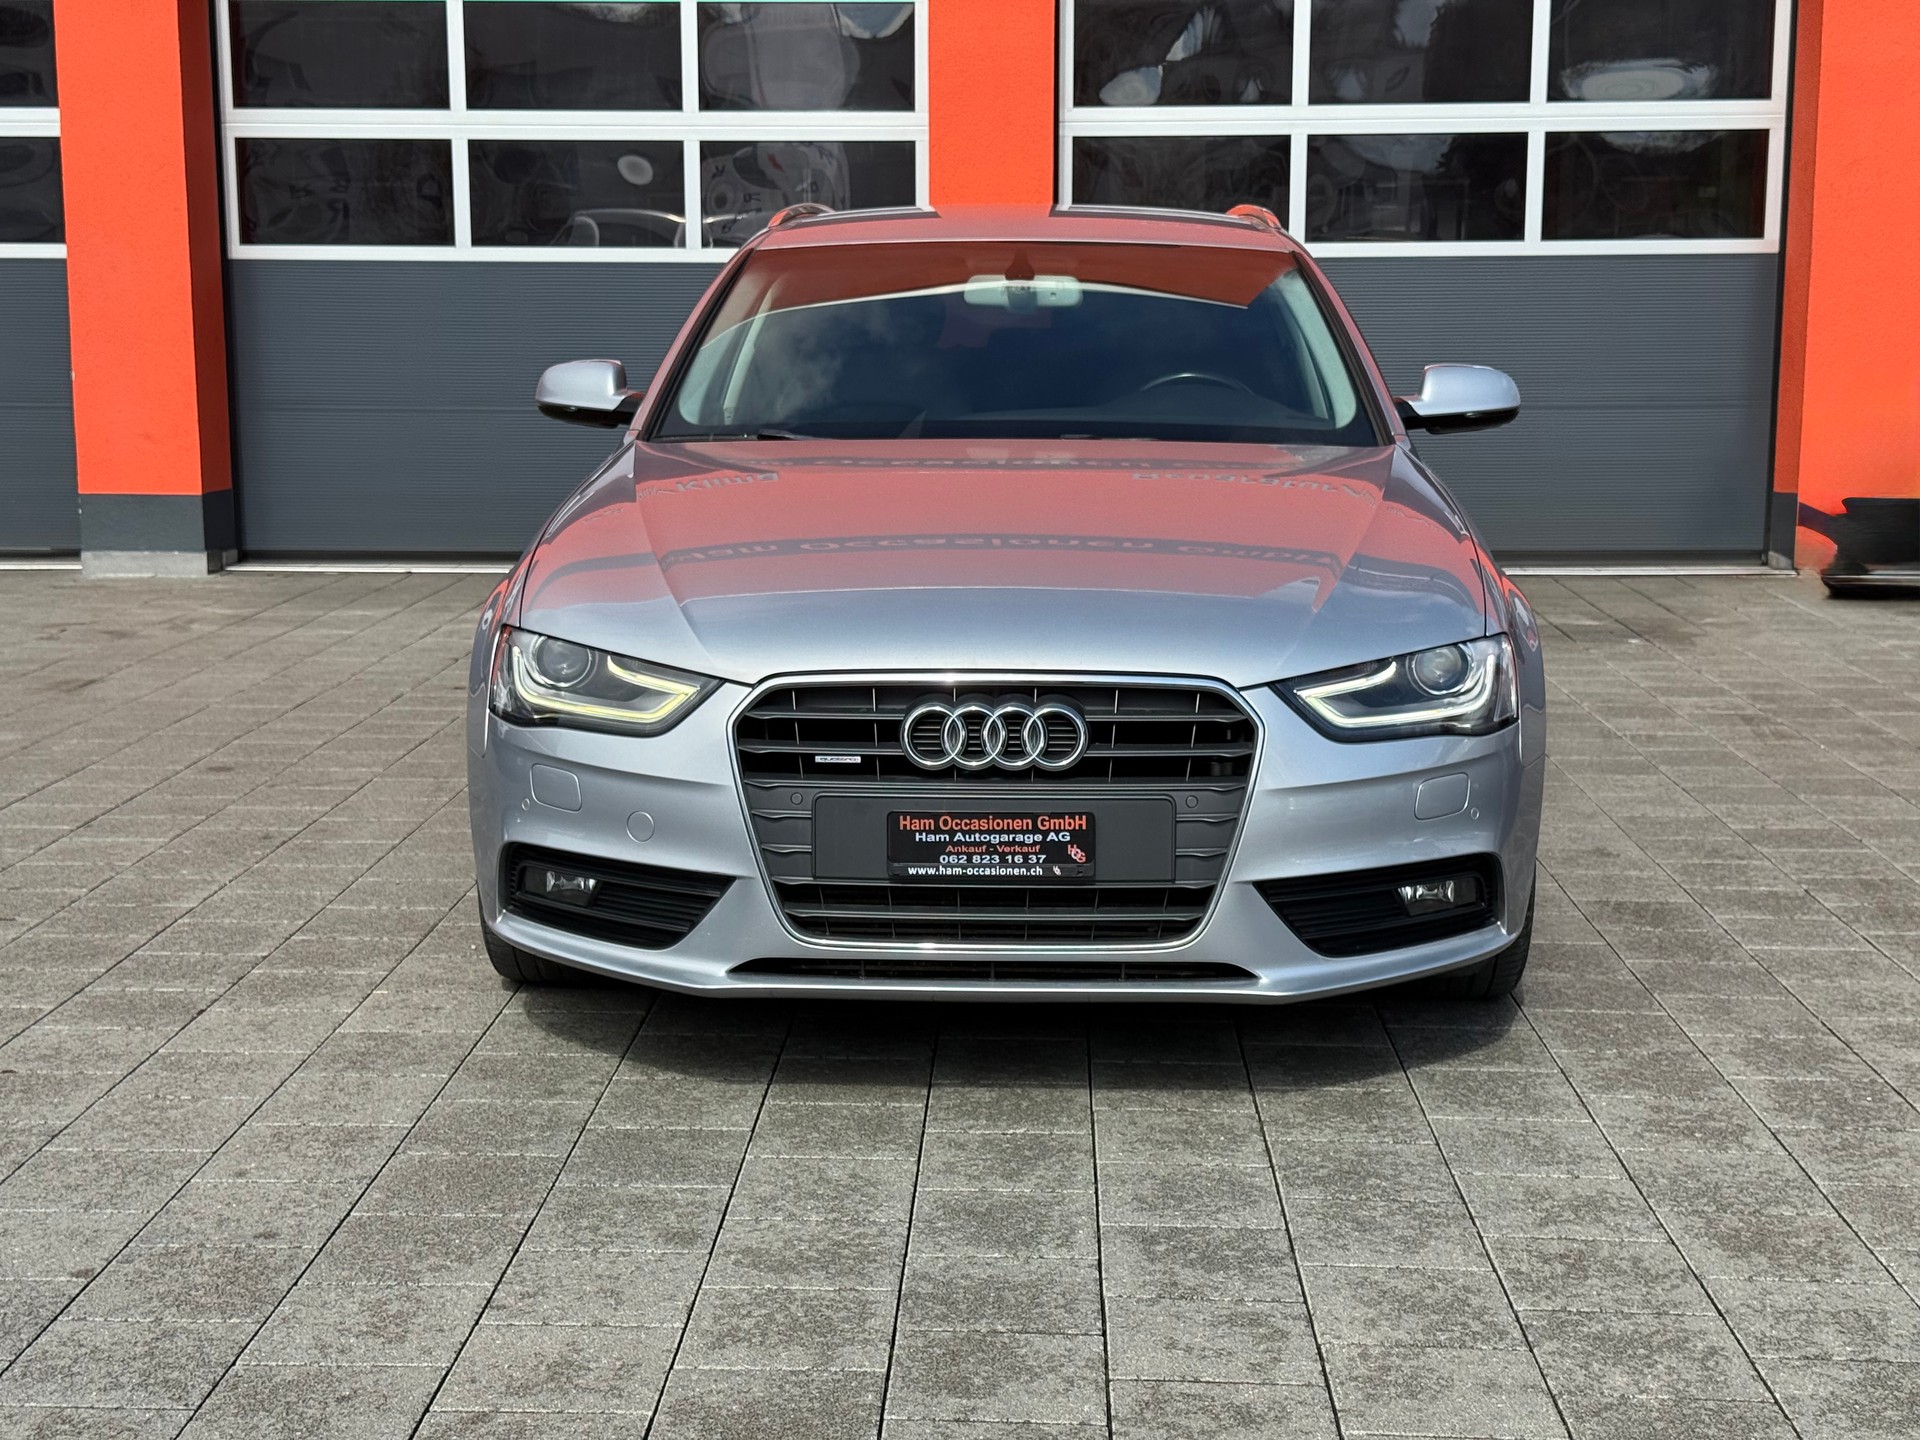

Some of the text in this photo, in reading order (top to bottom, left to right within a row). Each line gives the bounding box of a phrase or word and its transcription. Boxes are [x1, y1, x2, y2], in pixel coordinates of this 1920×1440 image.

[899, 815, 1087, 831] Ham Occasionen GmbH
[915, 832, 1071, 844] Ham Autogarage AG
[945, 845, 987, 853] Ankauf
[996, 845, 1041, 853] Verkauf
[939, 855, 1047, 864] 062 823 16 37
[907, 865, 1043, 876] www.ham-occasionen.ch
